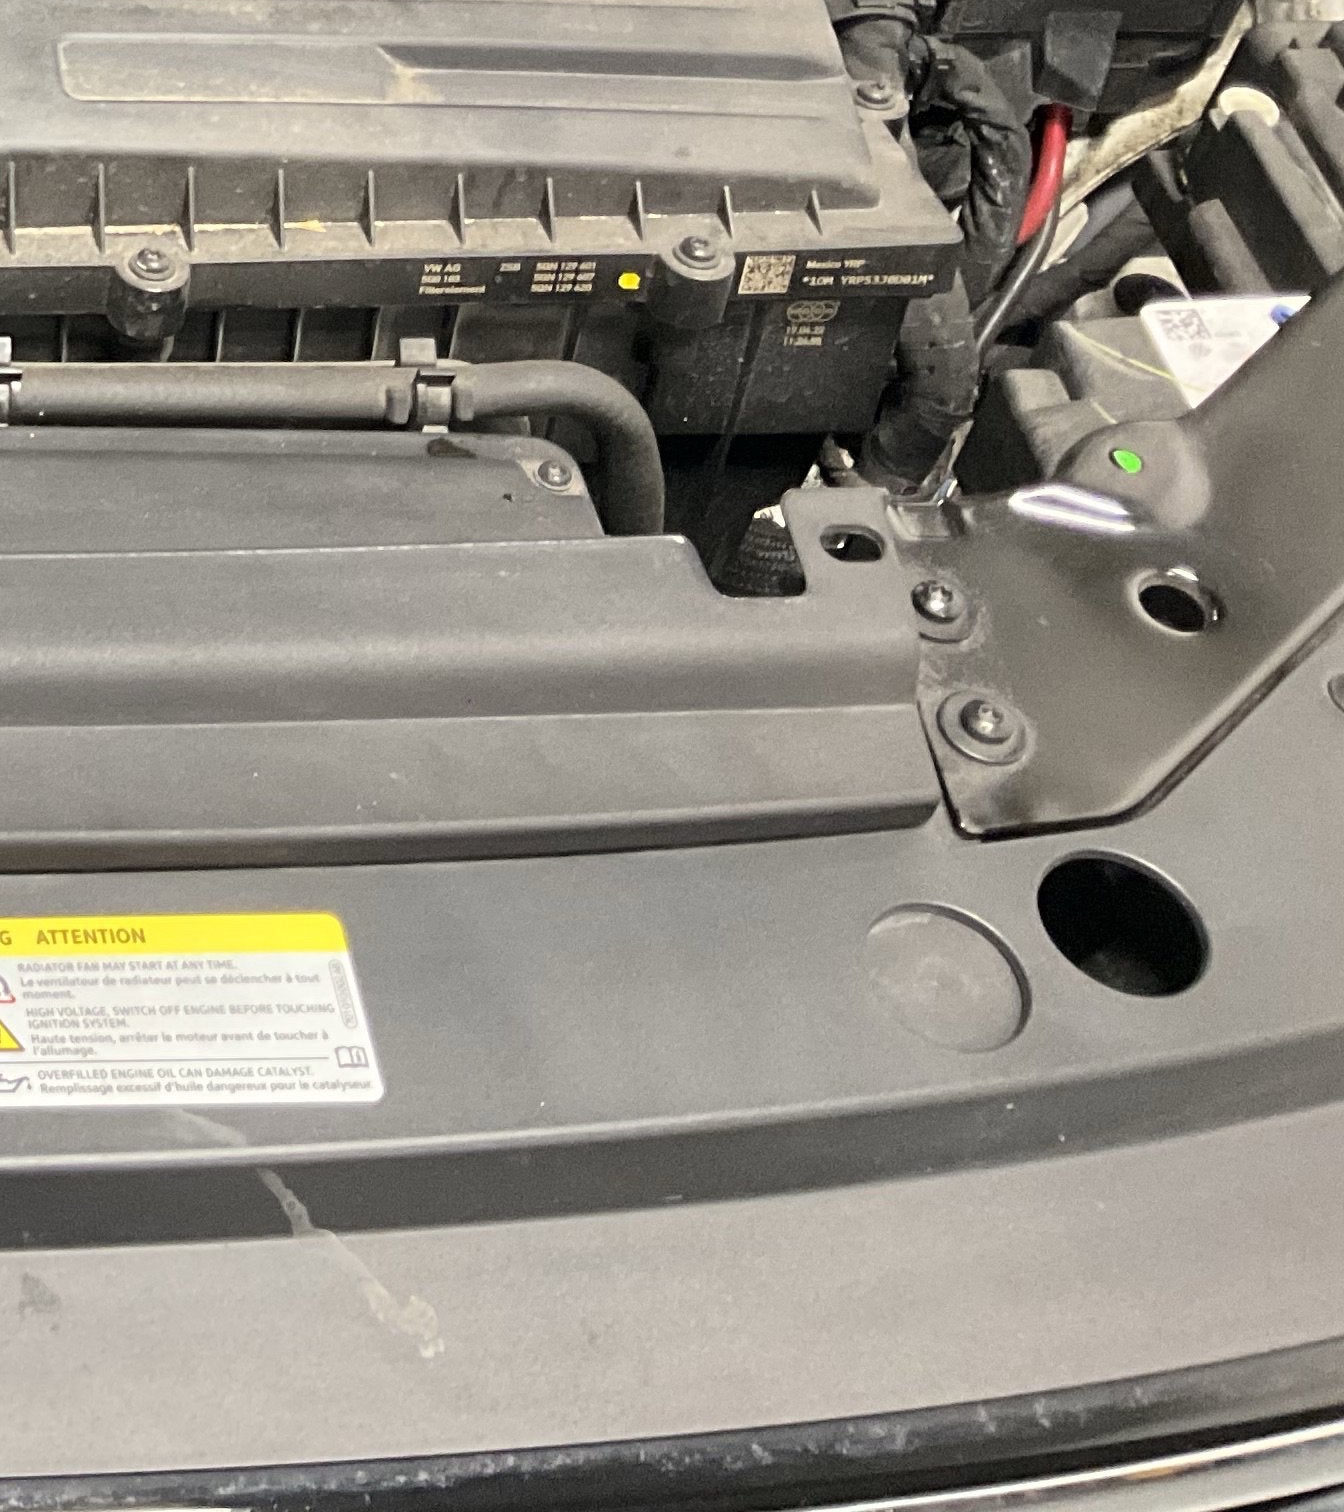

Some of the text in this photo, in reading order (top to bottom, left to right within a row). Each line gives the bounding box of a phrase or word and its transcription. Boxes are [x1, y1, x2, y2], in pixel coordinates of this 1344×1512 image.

[424, 263, 443, 273] VW
[36, 928, 146, 945] ATTENTION
[26, 1007, 54, 1017] HIGH
[113, 1006, 156, 1016] SWITCH
[159, 1005, 180, 1015] OFF
[184, 1005, 226, 1015] ENGINE
[229, 1004, 273, 1014] BEFORE
[276, 1003, 335, 1013] TOUCHING
[28, 1018, 80, 1029] IGNITION
[38, 1069, 108, 1080] OVERFILLED
[111, 1068, 154, 1079] ENGINE
[157, 1068, 175, 1079] OIL
[179, 1068, 202, 1077] CAN
[206, 1067, 254, 1077] DAMAGE
